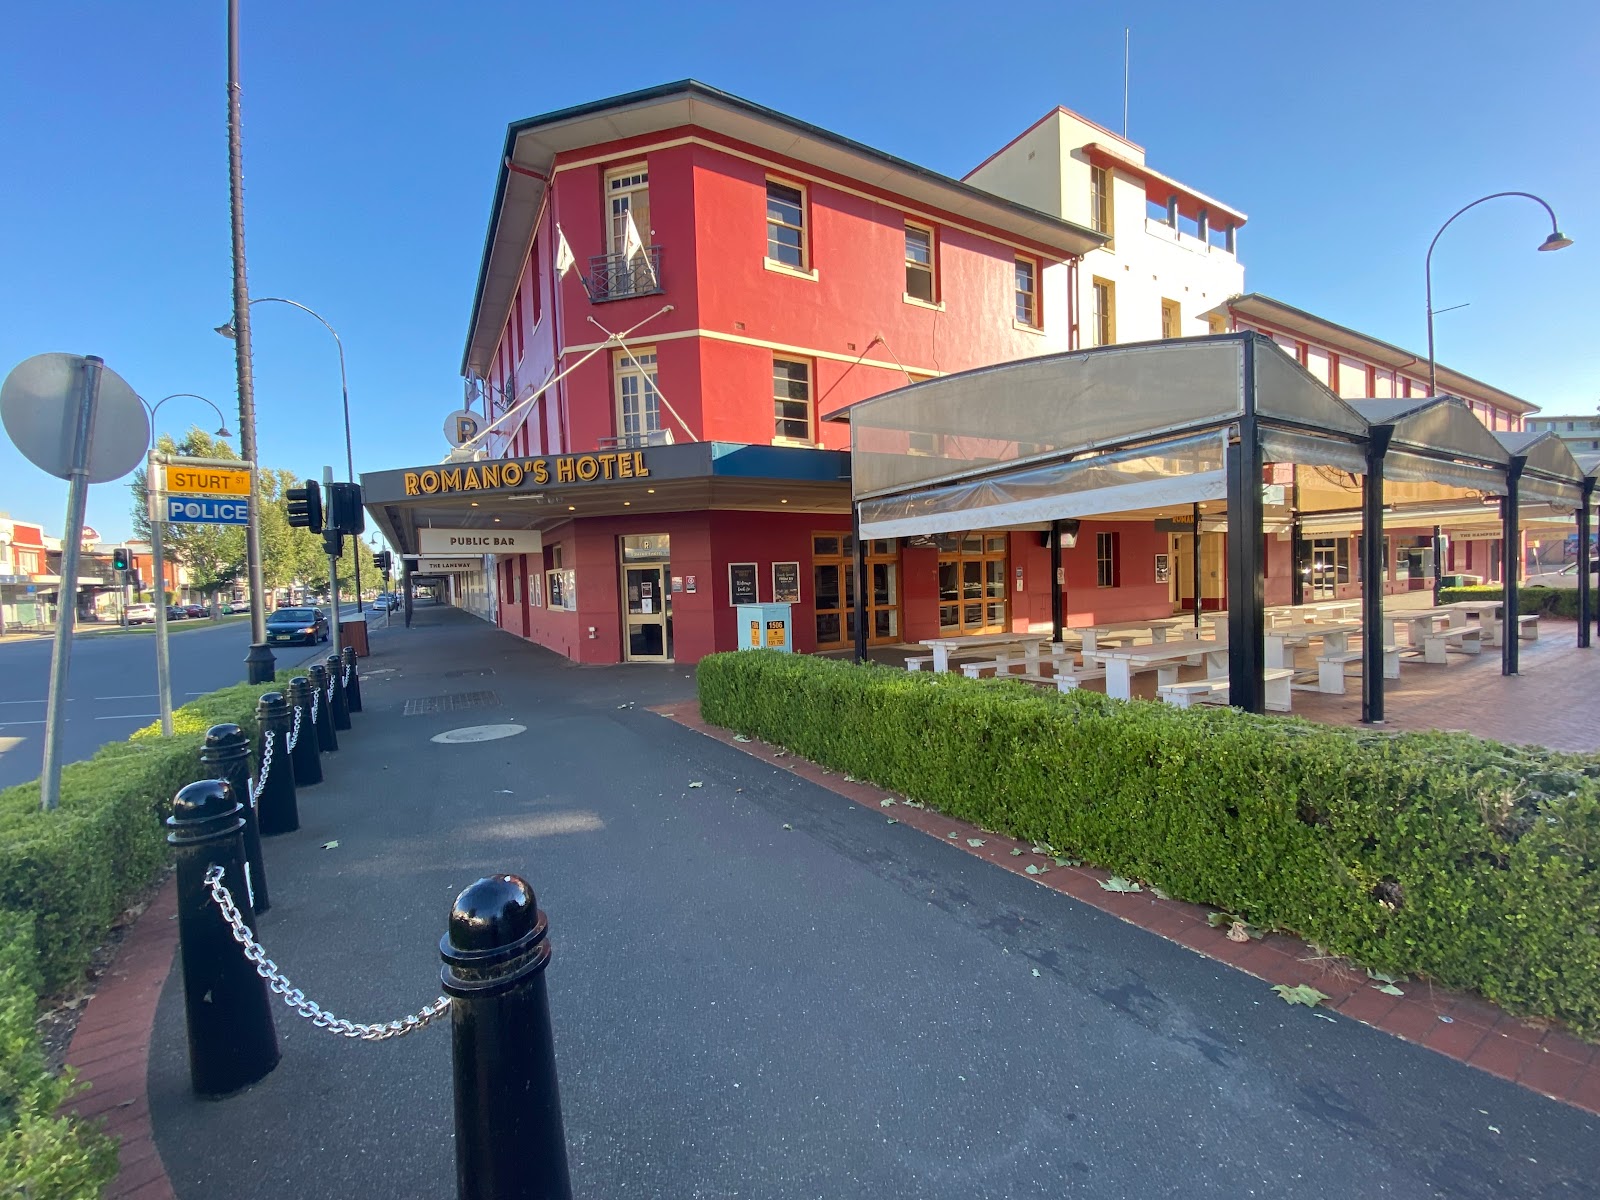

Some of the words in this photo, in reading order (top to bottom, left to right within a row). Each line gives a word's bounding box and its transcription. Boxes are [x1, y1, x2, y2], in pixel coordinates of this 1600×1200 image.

[175, 473, 231, 489] STURT
[404, 459, 549, 496] ROMANO'S
[556, 451, 649, 483] HOTEL
[170, 502, 248, 520] POLICE
[450, 537, 490, 546] PUBLIC
[493, 537, 515, 546] BAR
[769, 621, 783, 629] 1506
